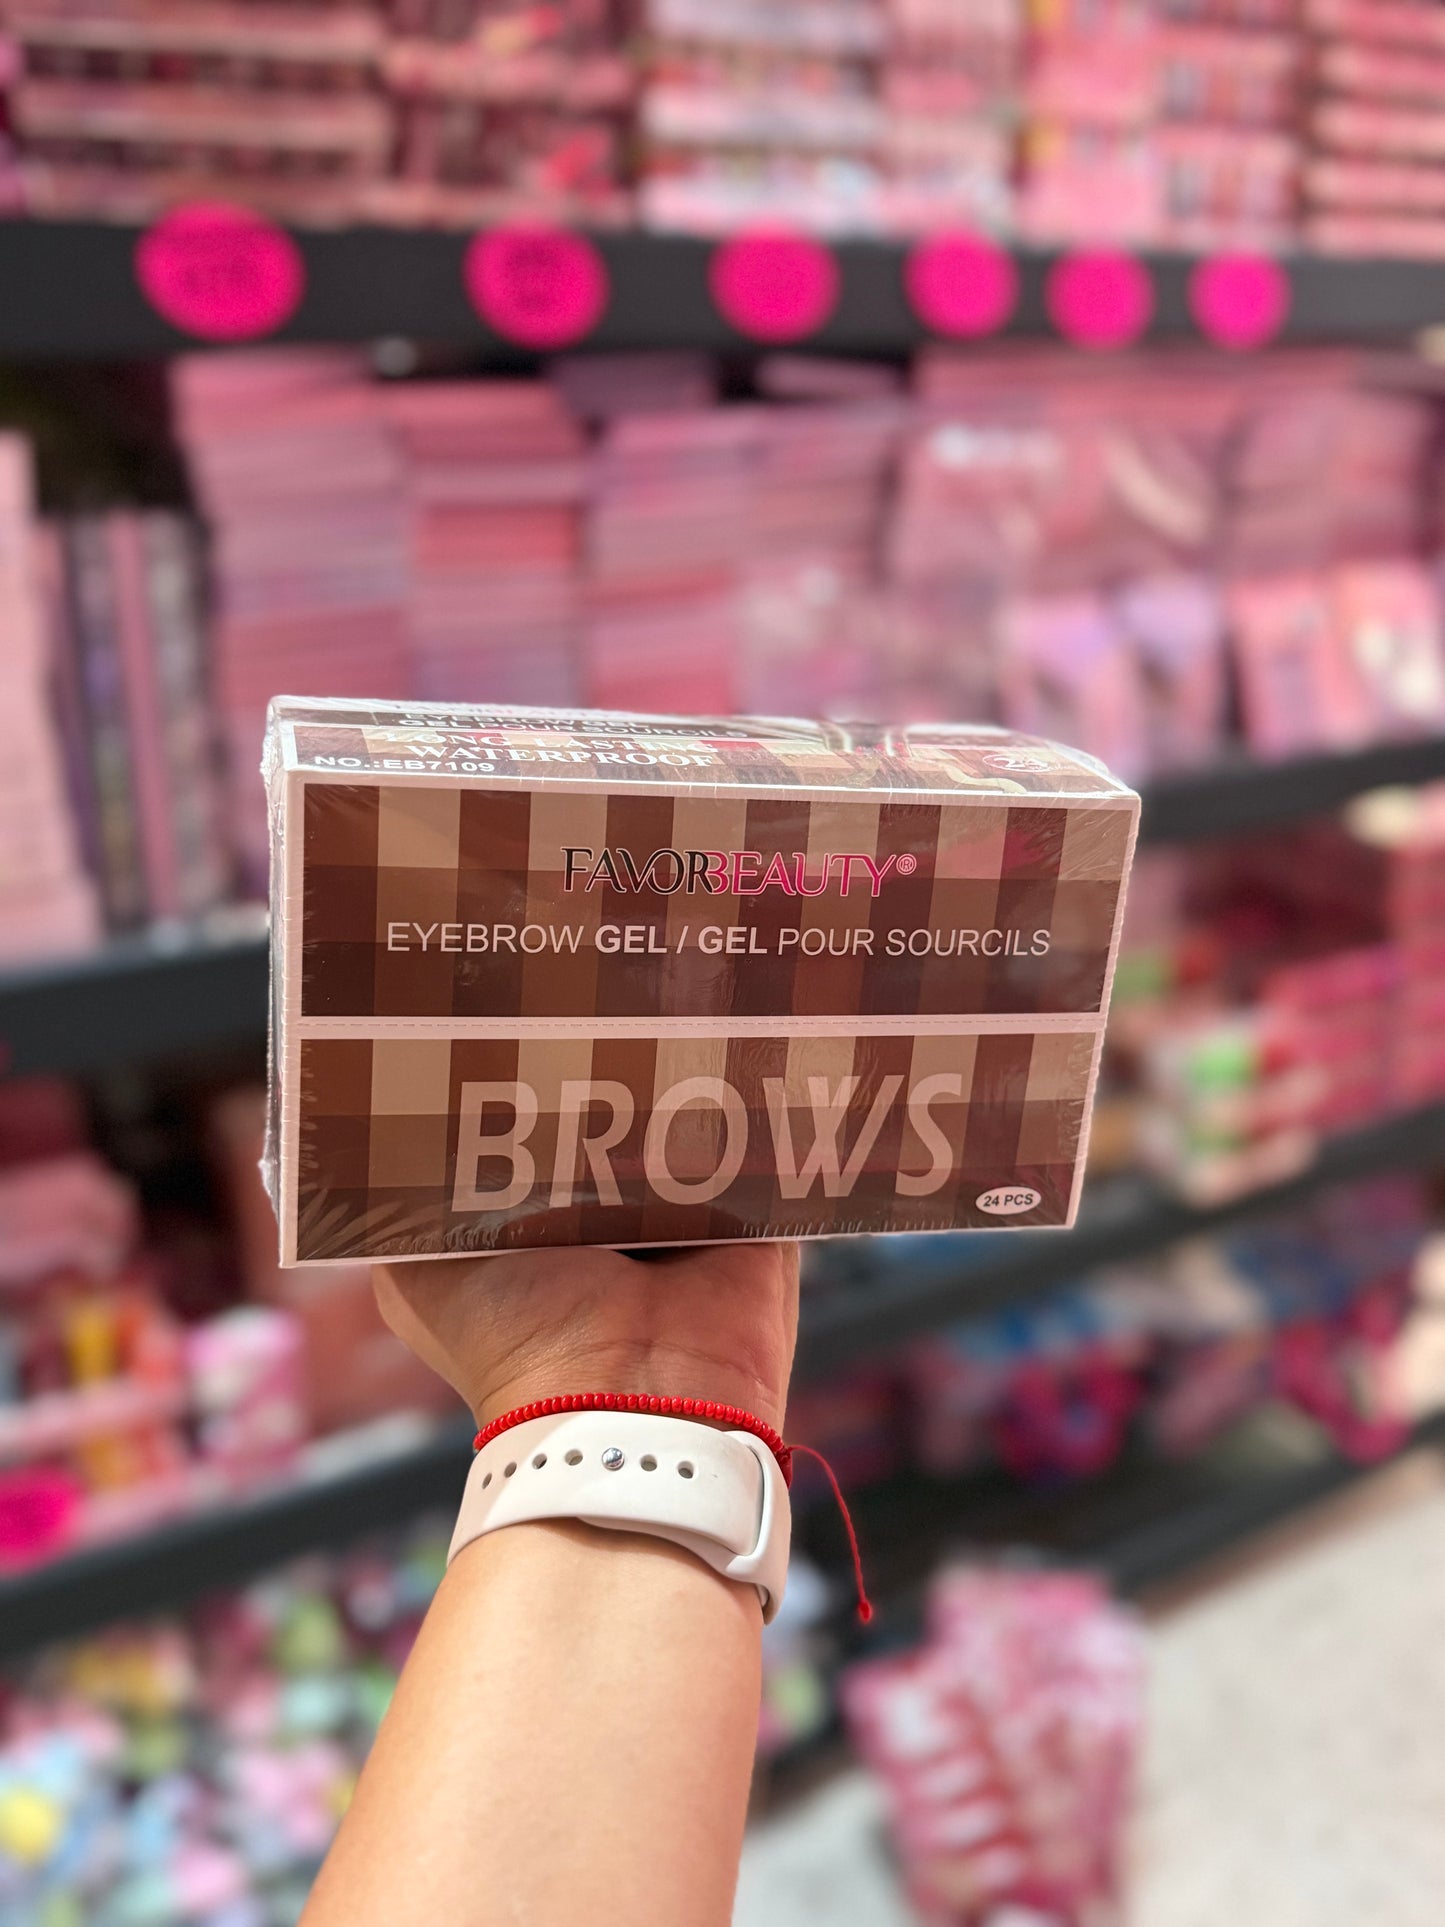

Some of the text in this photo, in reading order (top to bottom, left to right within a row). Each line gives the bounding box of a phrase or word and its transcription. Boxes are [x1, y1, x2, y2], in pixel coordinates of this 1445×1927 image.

[399, 719, 748, 738] GEL POUR SOURCILS
[385, 732, 719, 753] LONG LASTING
[404, 744, 713, 767] WATERPROOF
[386, 921, 585, 954] EYEBROW
[594, 924, 667, 955] GEL
[698, 926, 767, 955] GEL
[777, 928, 875, 956] POUR
[884, 929, 1052, 957] SOURCILS
[451, 1073, 963, 1213] BROWS
[983, 1193, 1034, 1207] 24 PCS
